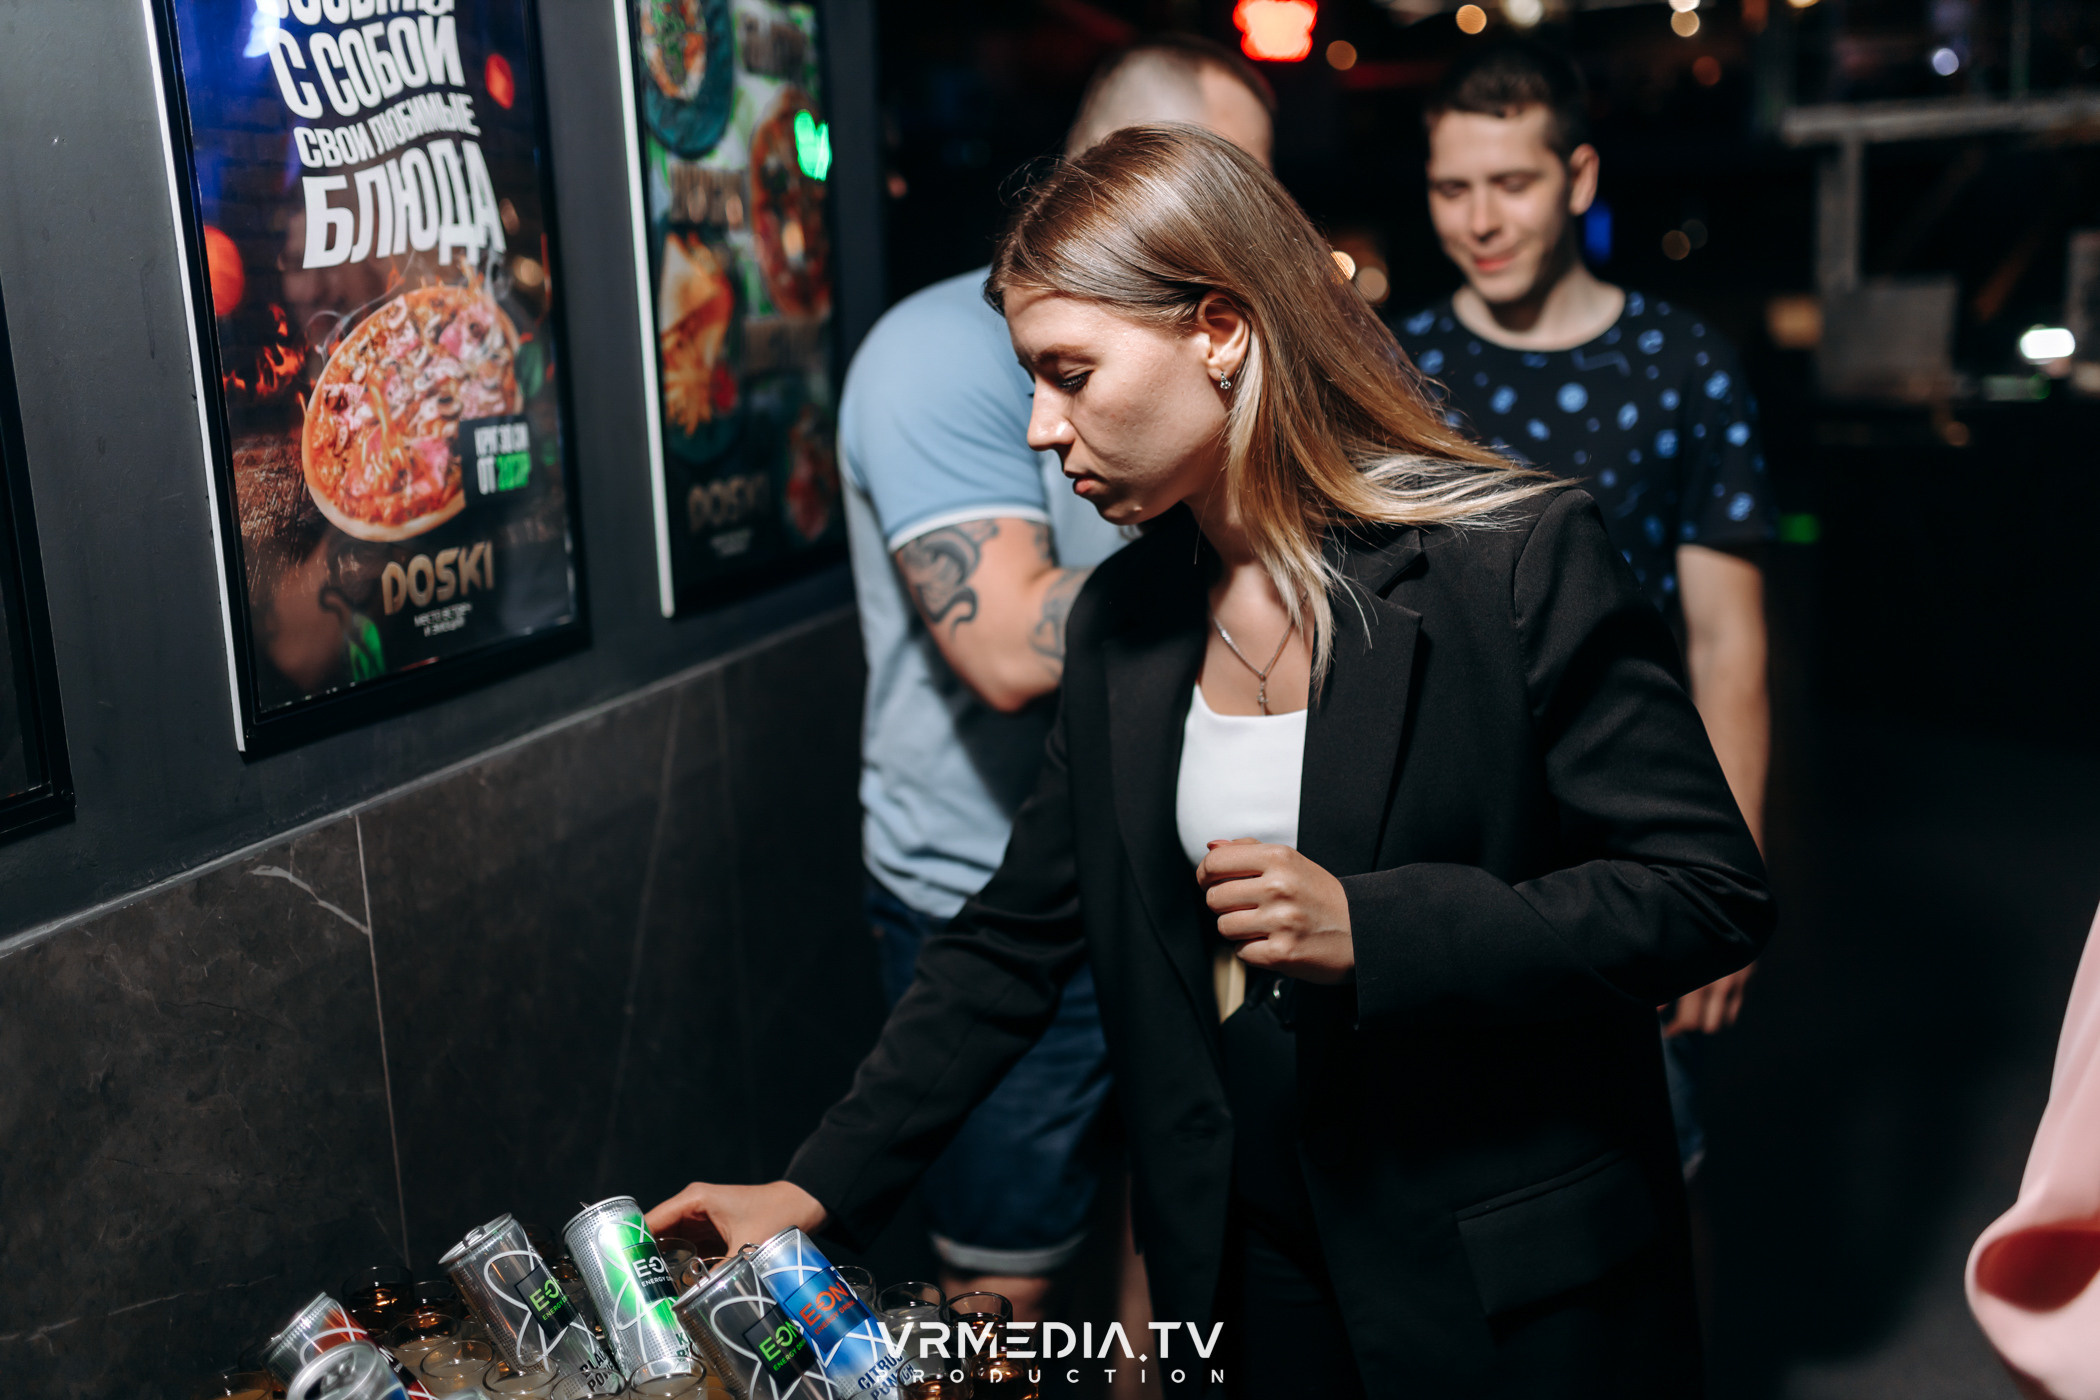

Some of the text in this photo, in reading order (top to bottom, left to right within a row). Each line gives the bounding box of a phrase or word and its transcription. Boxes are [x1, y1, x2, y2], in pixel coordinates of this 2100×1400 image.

[264, 4, 466, 119] С СОБОЙ
[293, 92, 481, 168] СВОИ ЛЮБИМЫЕ
[302, 138, 506, 269] БЛЮДА
[476, 455, 496, 495] ОТ
[381, 540, 494, 616] DOSKI
[641, 1276, 666, 1288] ENERGY
[542, 1300, 563, 1320] ENERGY
[815, 1310, 840, 1335] ENERGY
[580, 1348, 607, 1378] BLAC
[773, 1350, 797, 1371] ENERGY
